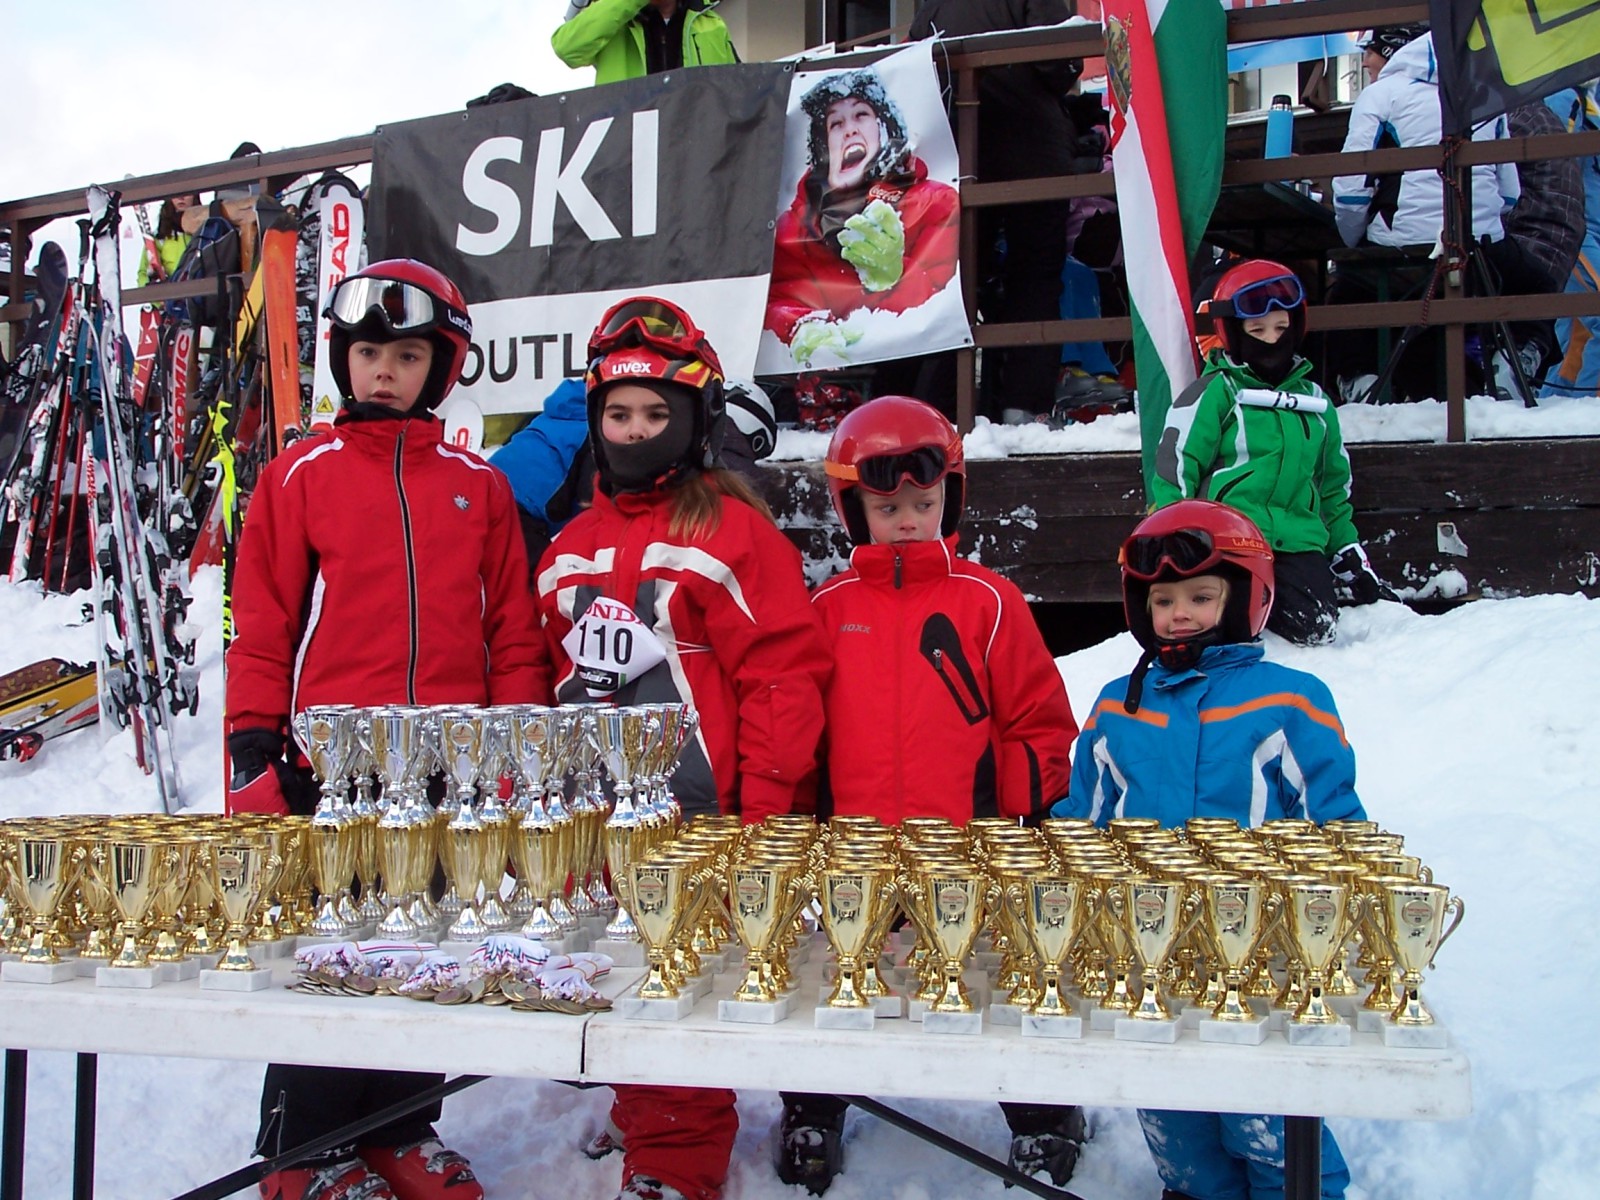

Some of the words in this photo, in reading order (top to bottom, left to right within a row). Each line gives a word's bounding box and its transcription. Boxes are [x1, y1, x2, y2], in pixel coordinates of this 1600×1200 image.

[456, 109, 659, 256] SKI
[612, 362, 652, 375] uvex
[174, 334, 190, 462] ATOMIC
[223, 595, 231, 639] LEKI
[579, 620, 633, 665] 110
